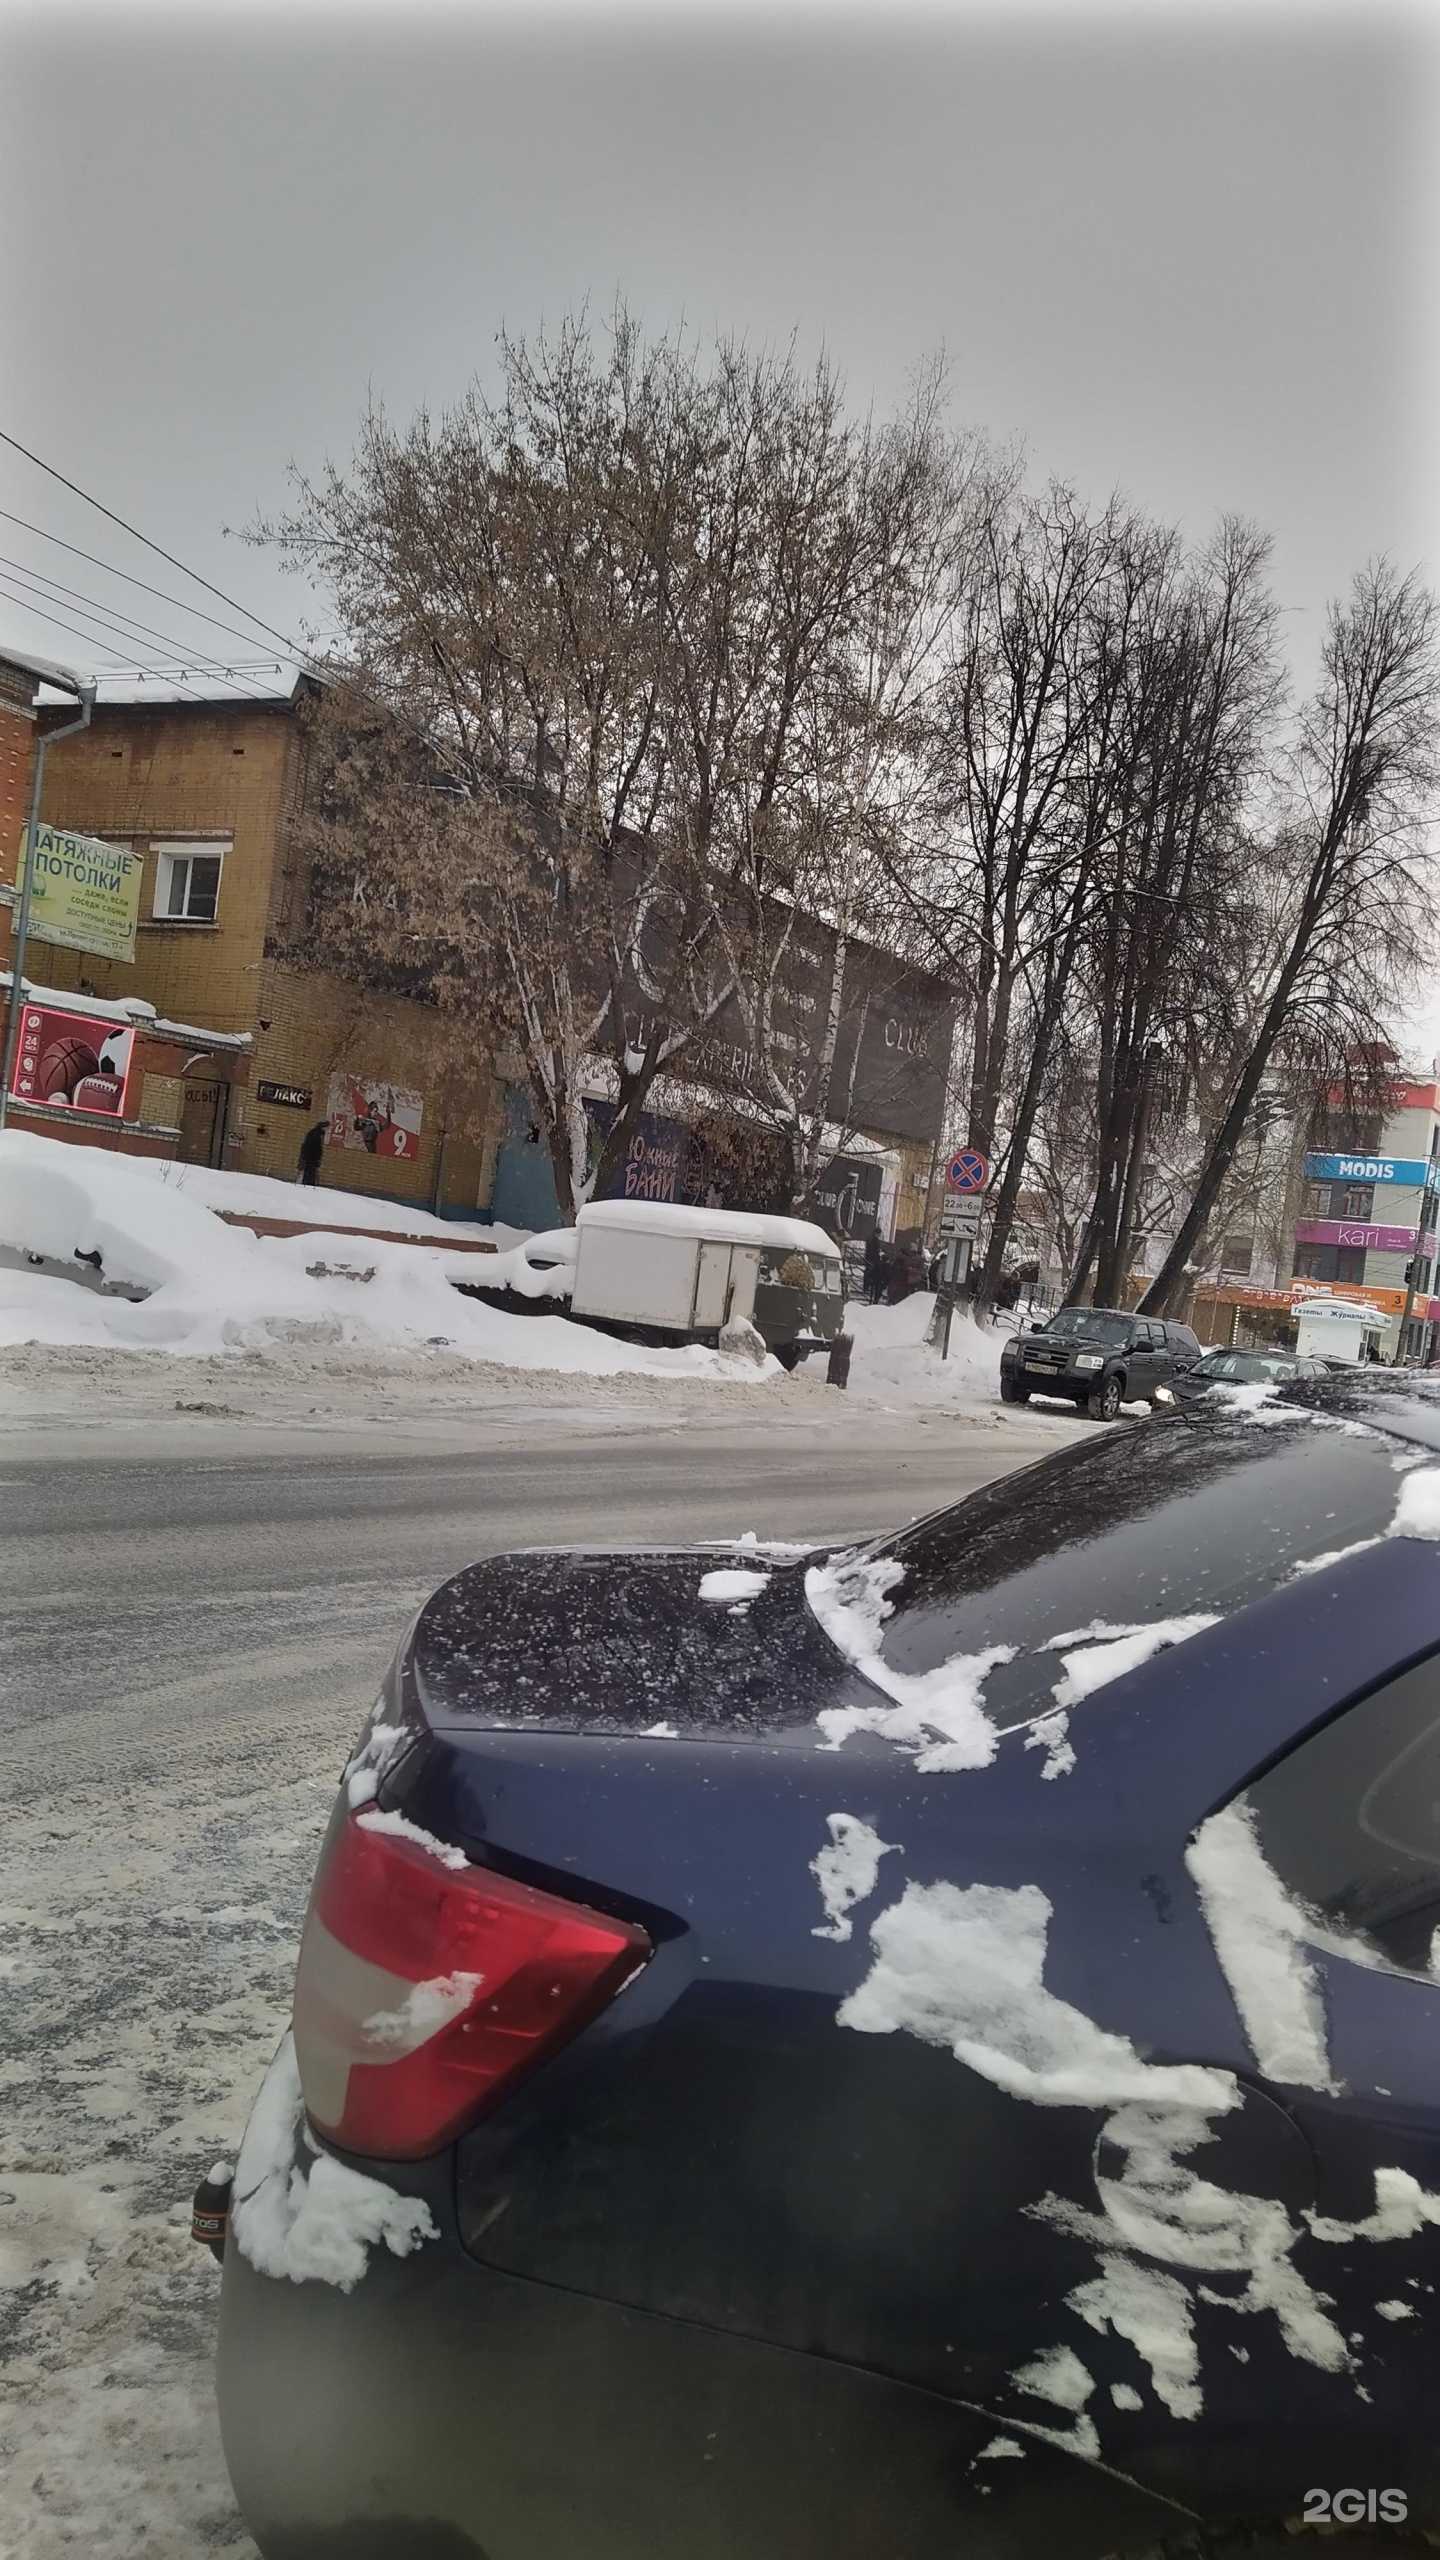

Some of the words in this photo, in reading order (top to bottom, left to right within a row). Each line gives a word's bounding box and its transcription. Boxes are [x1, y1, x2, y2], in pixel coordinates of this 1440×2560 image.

[35, 853, 121, 894] ПОТОЛКИ
[25, 1035, 38, 1047] 24
[394, 1129, 407, 1154] 9
[1339, 1160, 1395, 1179] MODIS
[1337, 1224, 1380, 1247] kari
[1408, 1230, 1417, 1241] 3
[1394, 1295, 1402, 1305] 3
[1293, 1307, 1323, 1317] Газеты
[1329, 1310, 1366, 1321] Журналы
